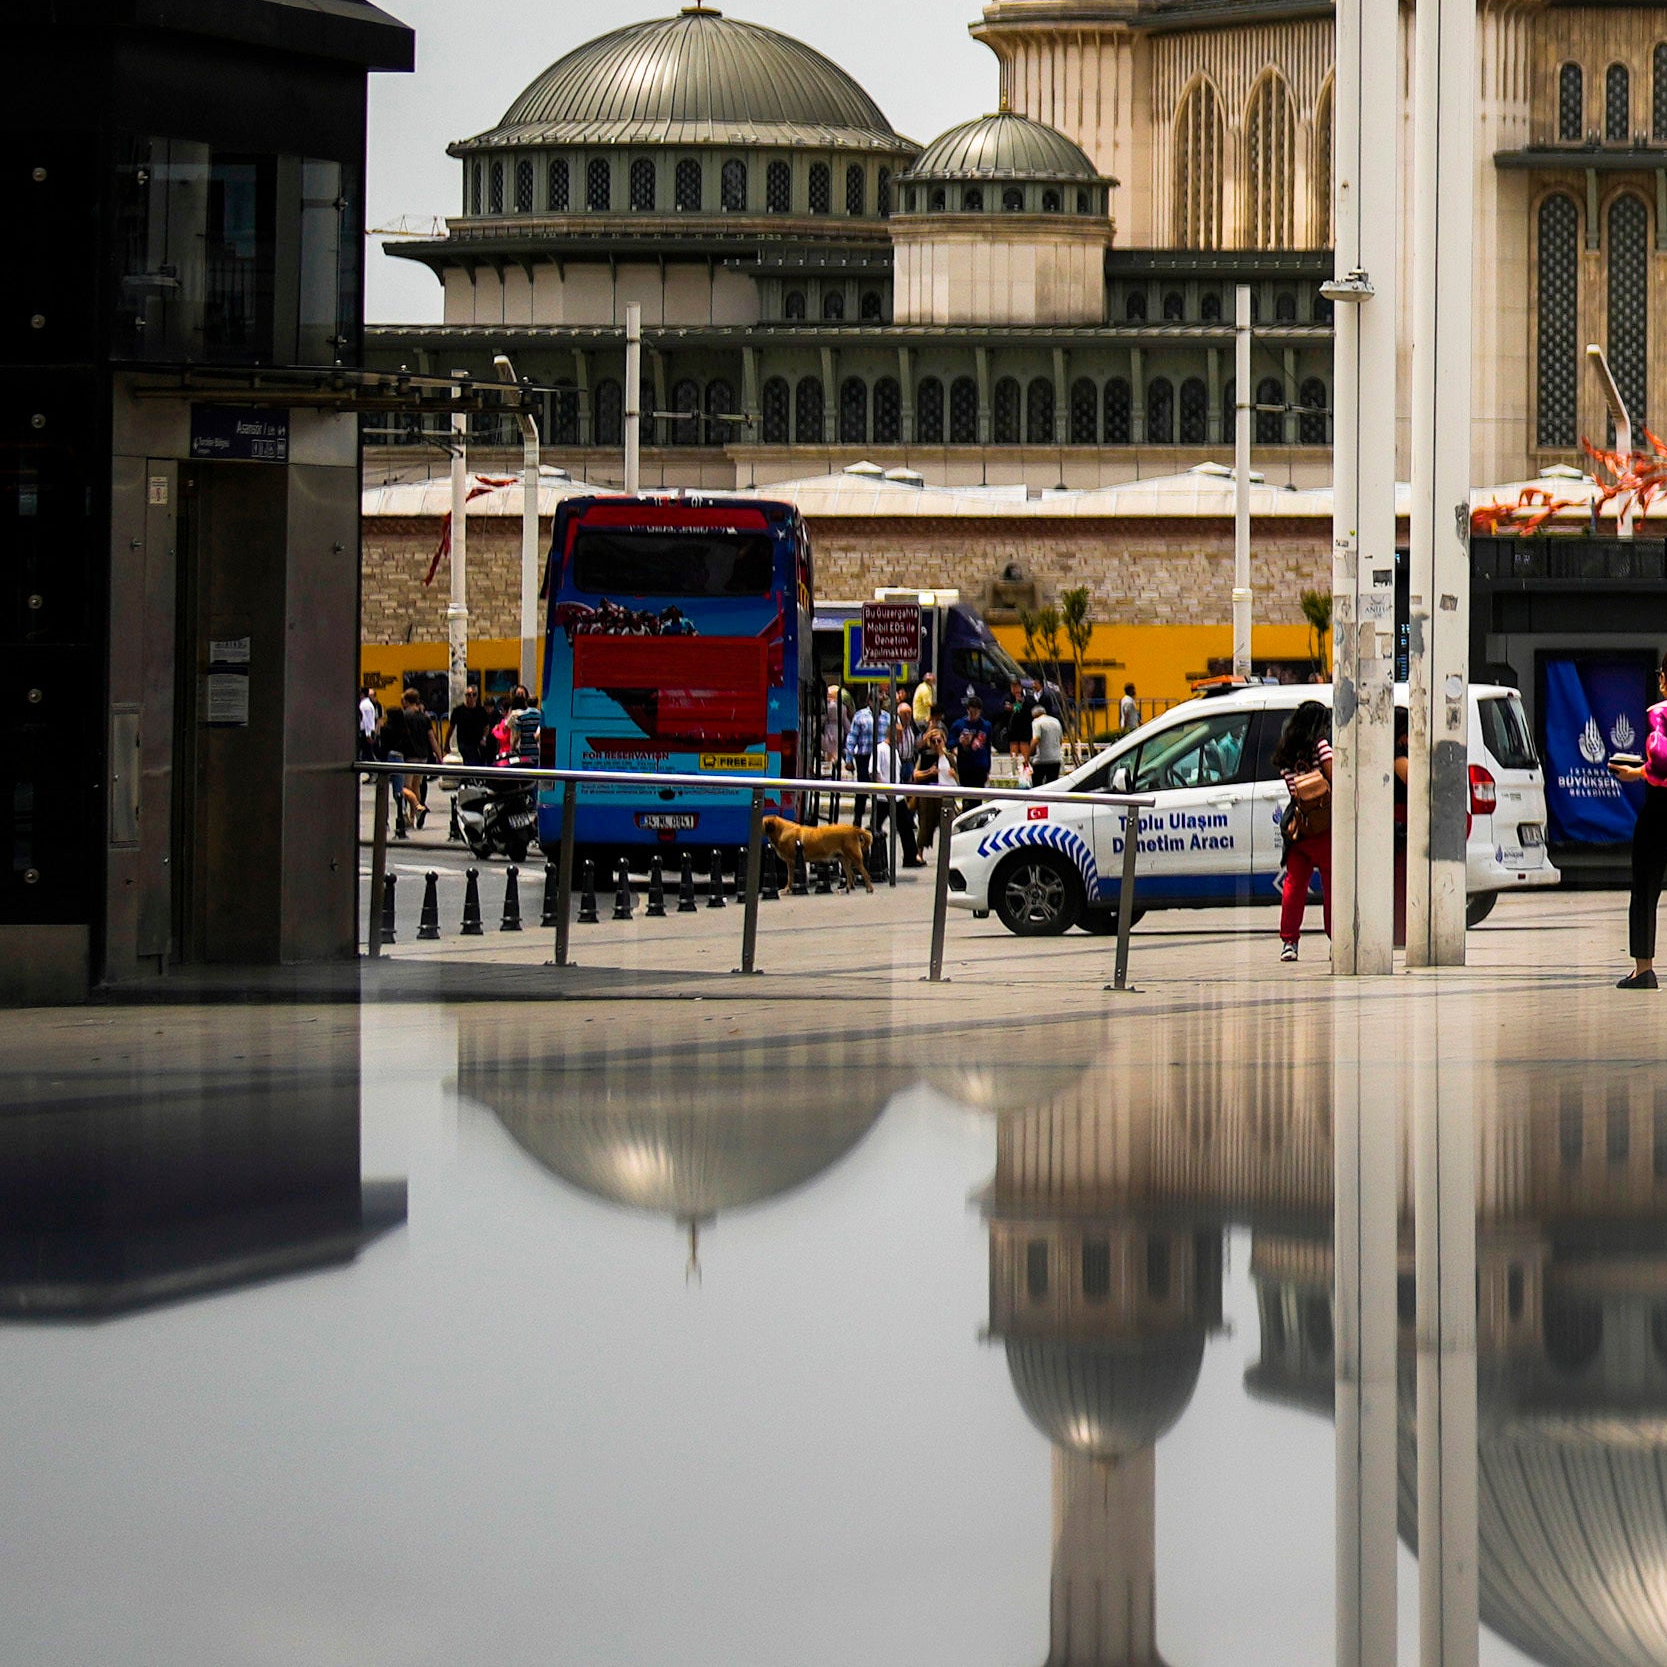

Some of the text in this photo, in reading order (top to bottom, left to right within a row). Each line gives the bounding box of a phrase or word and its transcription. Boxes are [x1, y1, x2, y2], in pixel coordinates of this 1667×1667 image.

[867, 621, 888, 634] Mobil
[874, 633, 909, 646] Denetim
[720, 756, 747, 767] FREE
[1118, 813, 1228, 833] Tplu Ulaşım
[1112, 833, 1235, 854] Dnetim Aracı
